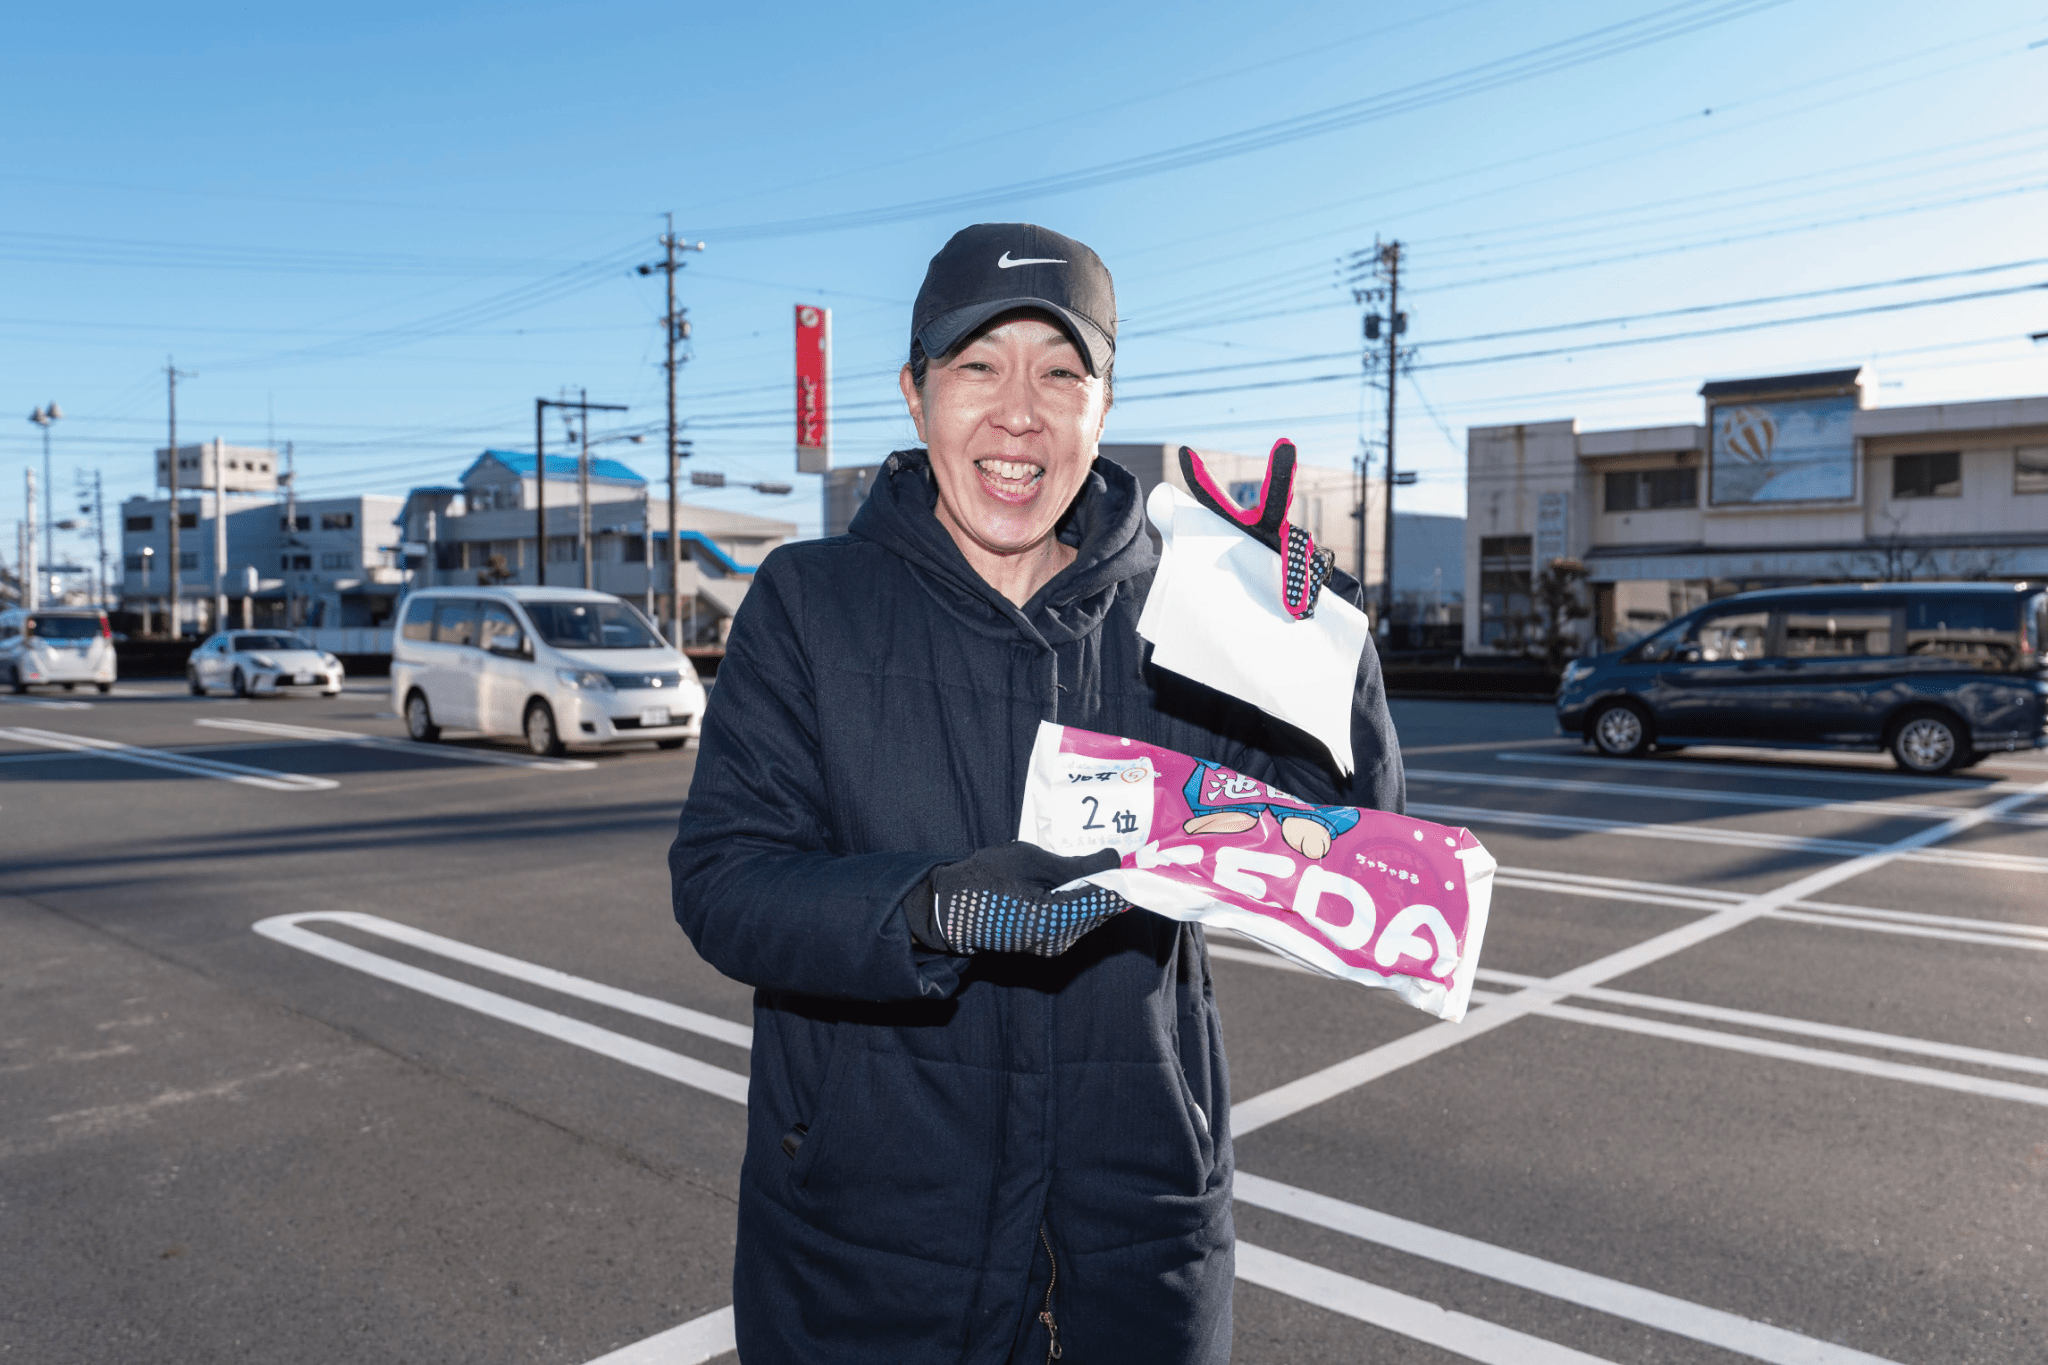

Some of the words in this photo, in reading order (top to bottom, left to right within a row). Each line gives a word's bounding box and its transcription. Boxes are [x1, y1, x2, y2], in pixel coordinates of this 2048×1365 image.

[1082, 795, 1139, 834] 2位
[1355, 853, 1420, 885] ちゃちゃまる
